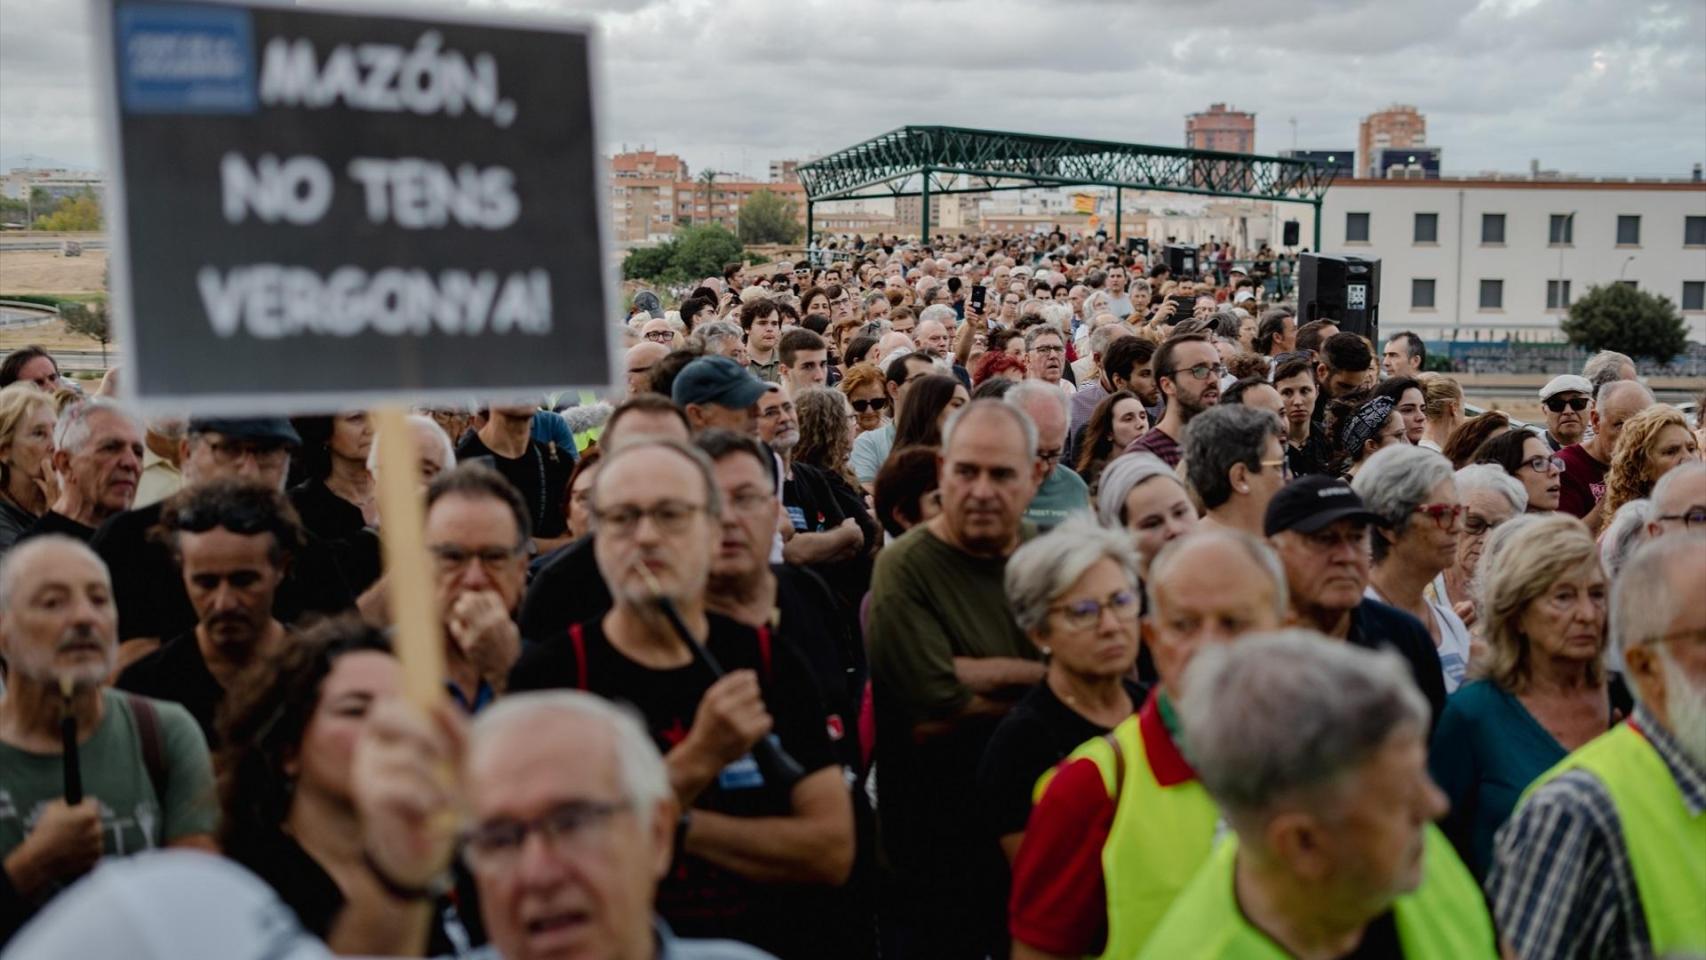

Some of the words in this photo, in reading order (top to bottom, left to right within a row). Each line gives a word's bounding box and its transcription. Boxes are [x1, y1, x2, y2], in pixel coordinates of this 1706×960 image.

[259, 30, 517, 126] MAZÓN,
[220, 153, 334, 224] NO
[348, 156, 521, 229] TENS
[197, 263, 553, 340] VERGONYA!
